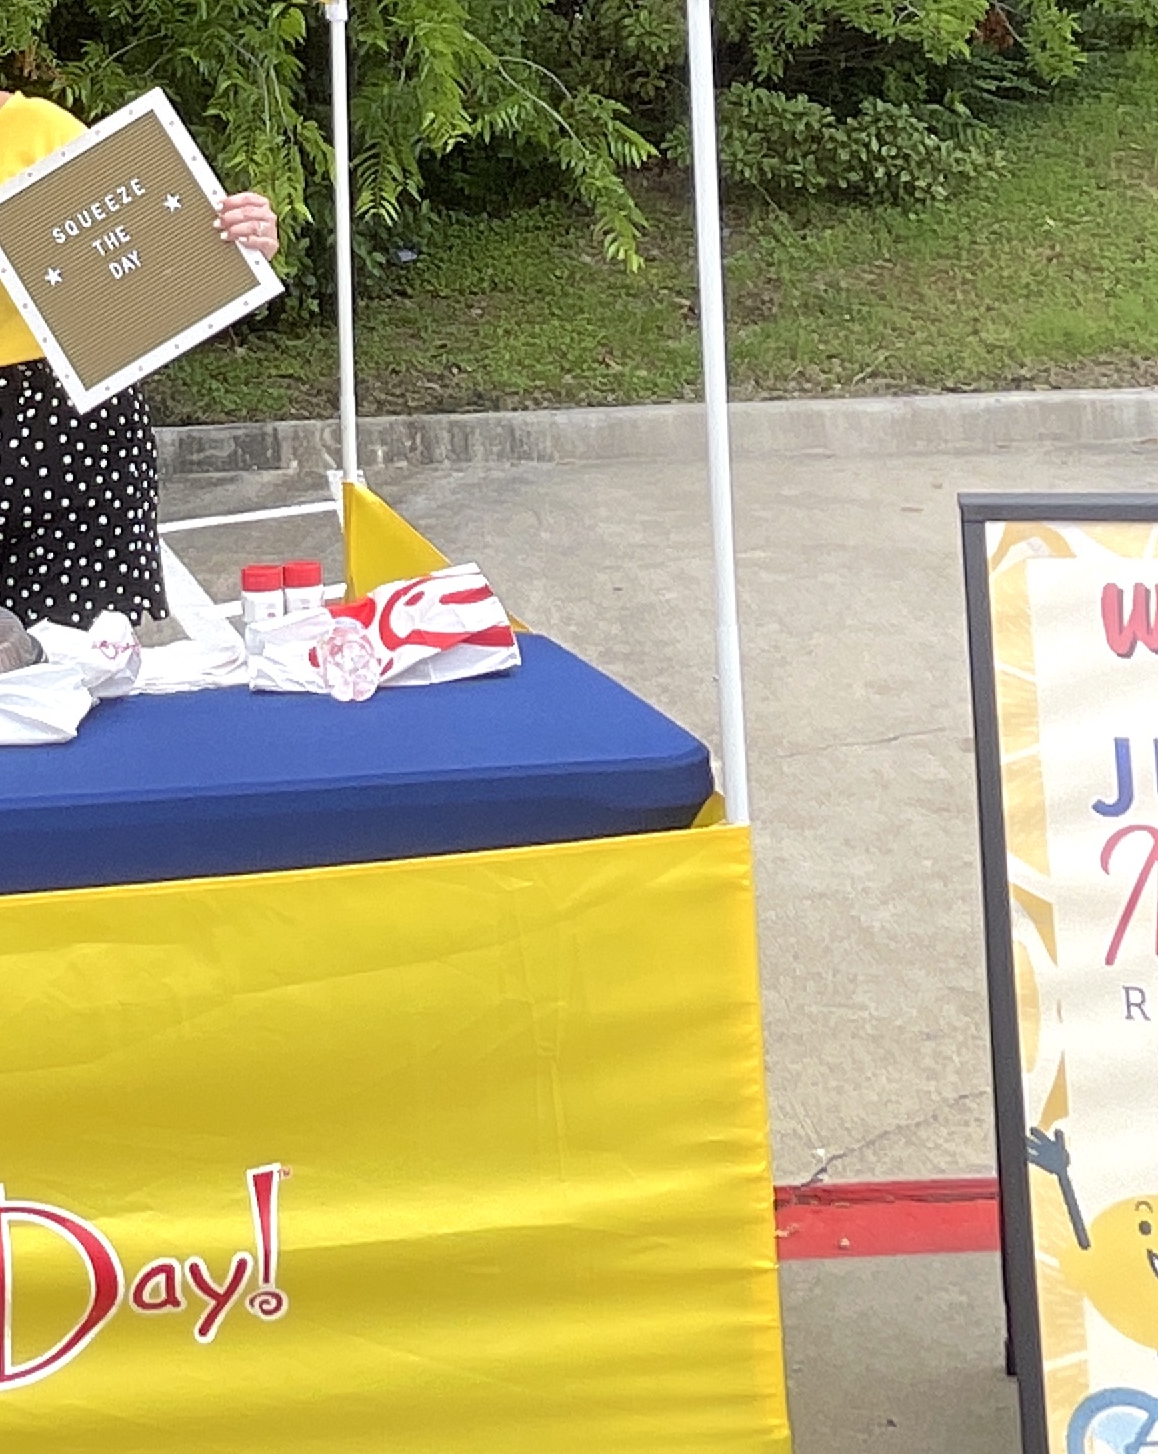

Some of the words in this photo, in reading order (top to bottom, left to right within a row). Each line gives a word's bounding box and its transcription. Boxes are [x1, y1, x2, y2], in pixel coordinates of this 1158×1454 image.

[51, 177, 146, 244] SQUEEZE
[92, 225, 131, 257] THE
[108, 249, 142, 280] DAY
